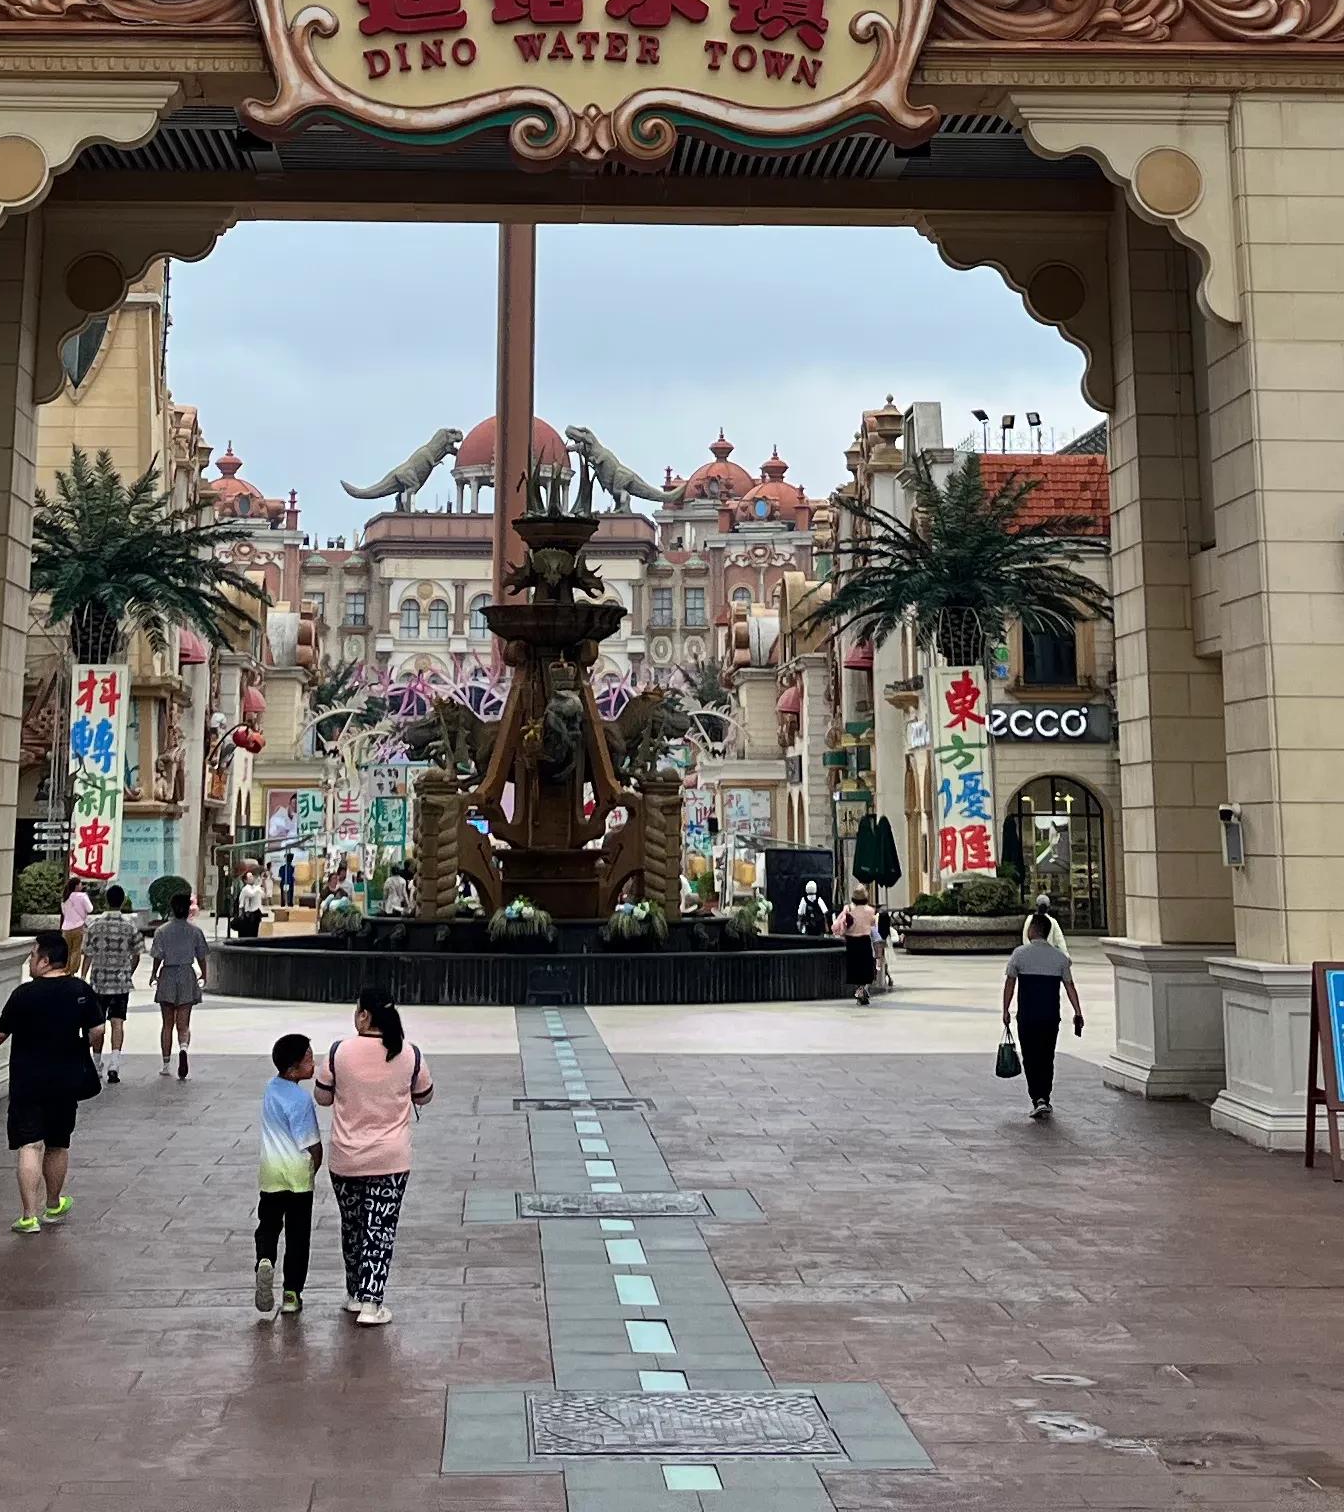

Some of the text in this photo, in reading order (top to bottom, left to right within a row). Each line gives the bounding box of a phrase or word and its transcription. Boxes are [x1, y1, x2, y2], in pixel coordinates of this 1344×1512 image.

[362, 30, 824, 89] DINO WATER TOWN
[985, 706, 1089, 738] ecco
